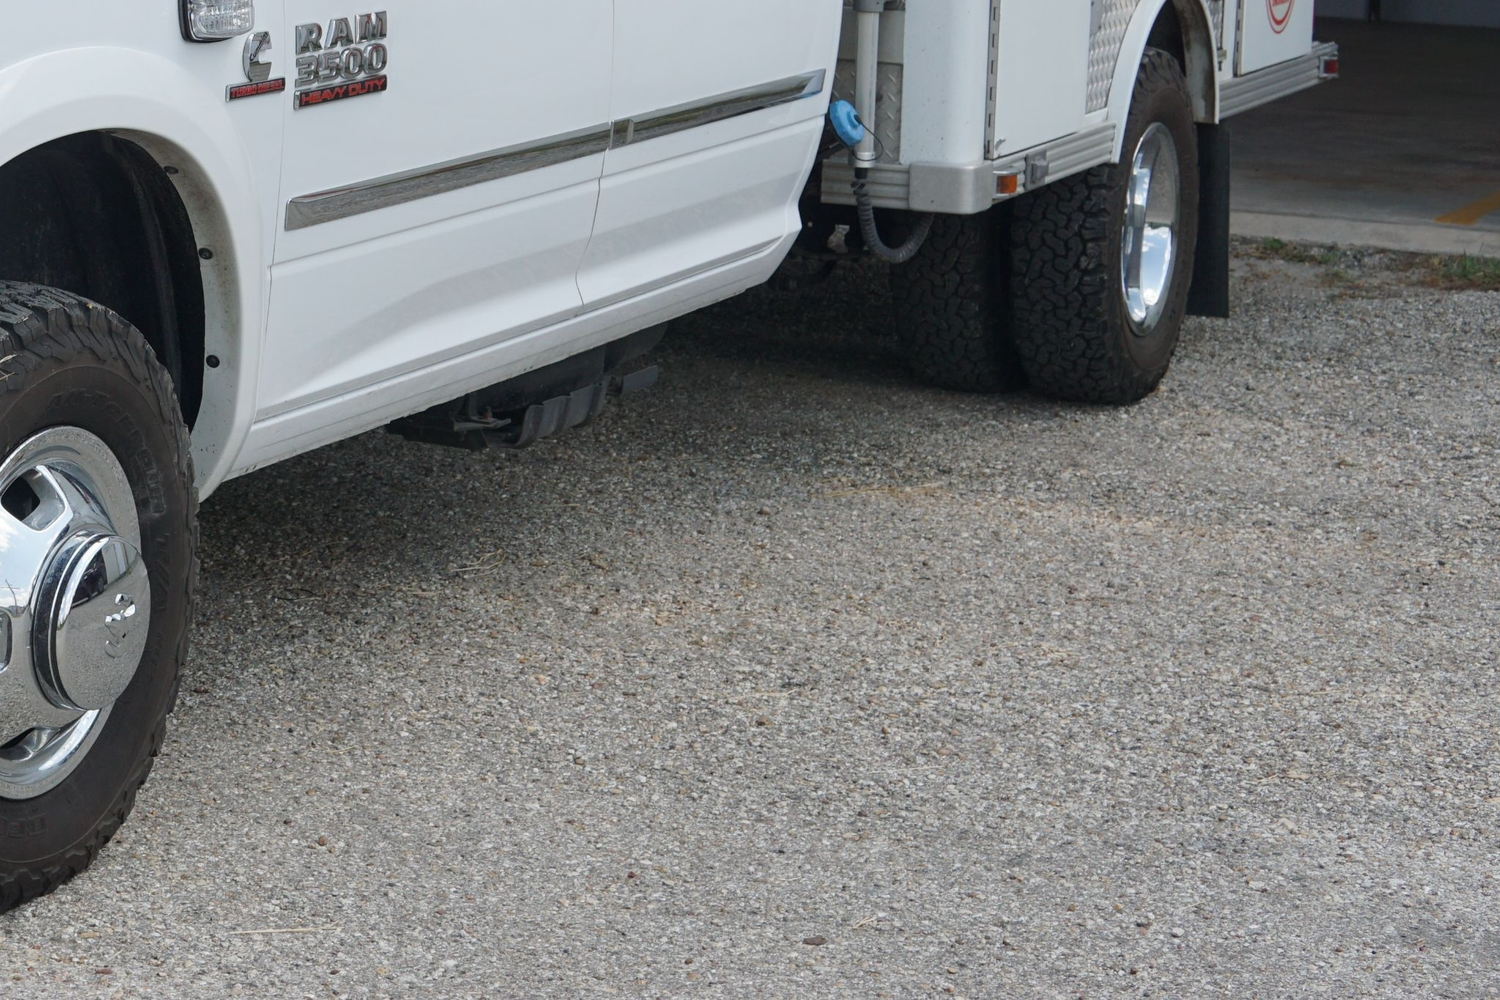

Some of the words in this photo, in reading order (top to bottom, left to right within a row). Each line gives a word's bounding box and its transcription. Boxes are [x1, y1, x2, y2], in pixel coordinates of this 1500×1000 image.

[295, 10, 387, 55] RAM
[294, 43, 388, 88] 3500
[231, 84, 257, 98] TURBO
[257, 80, 284, 94] DIESEL
[301, 84, 346, 105] HEAVY
[350, 77, 385, 96] DUTY
